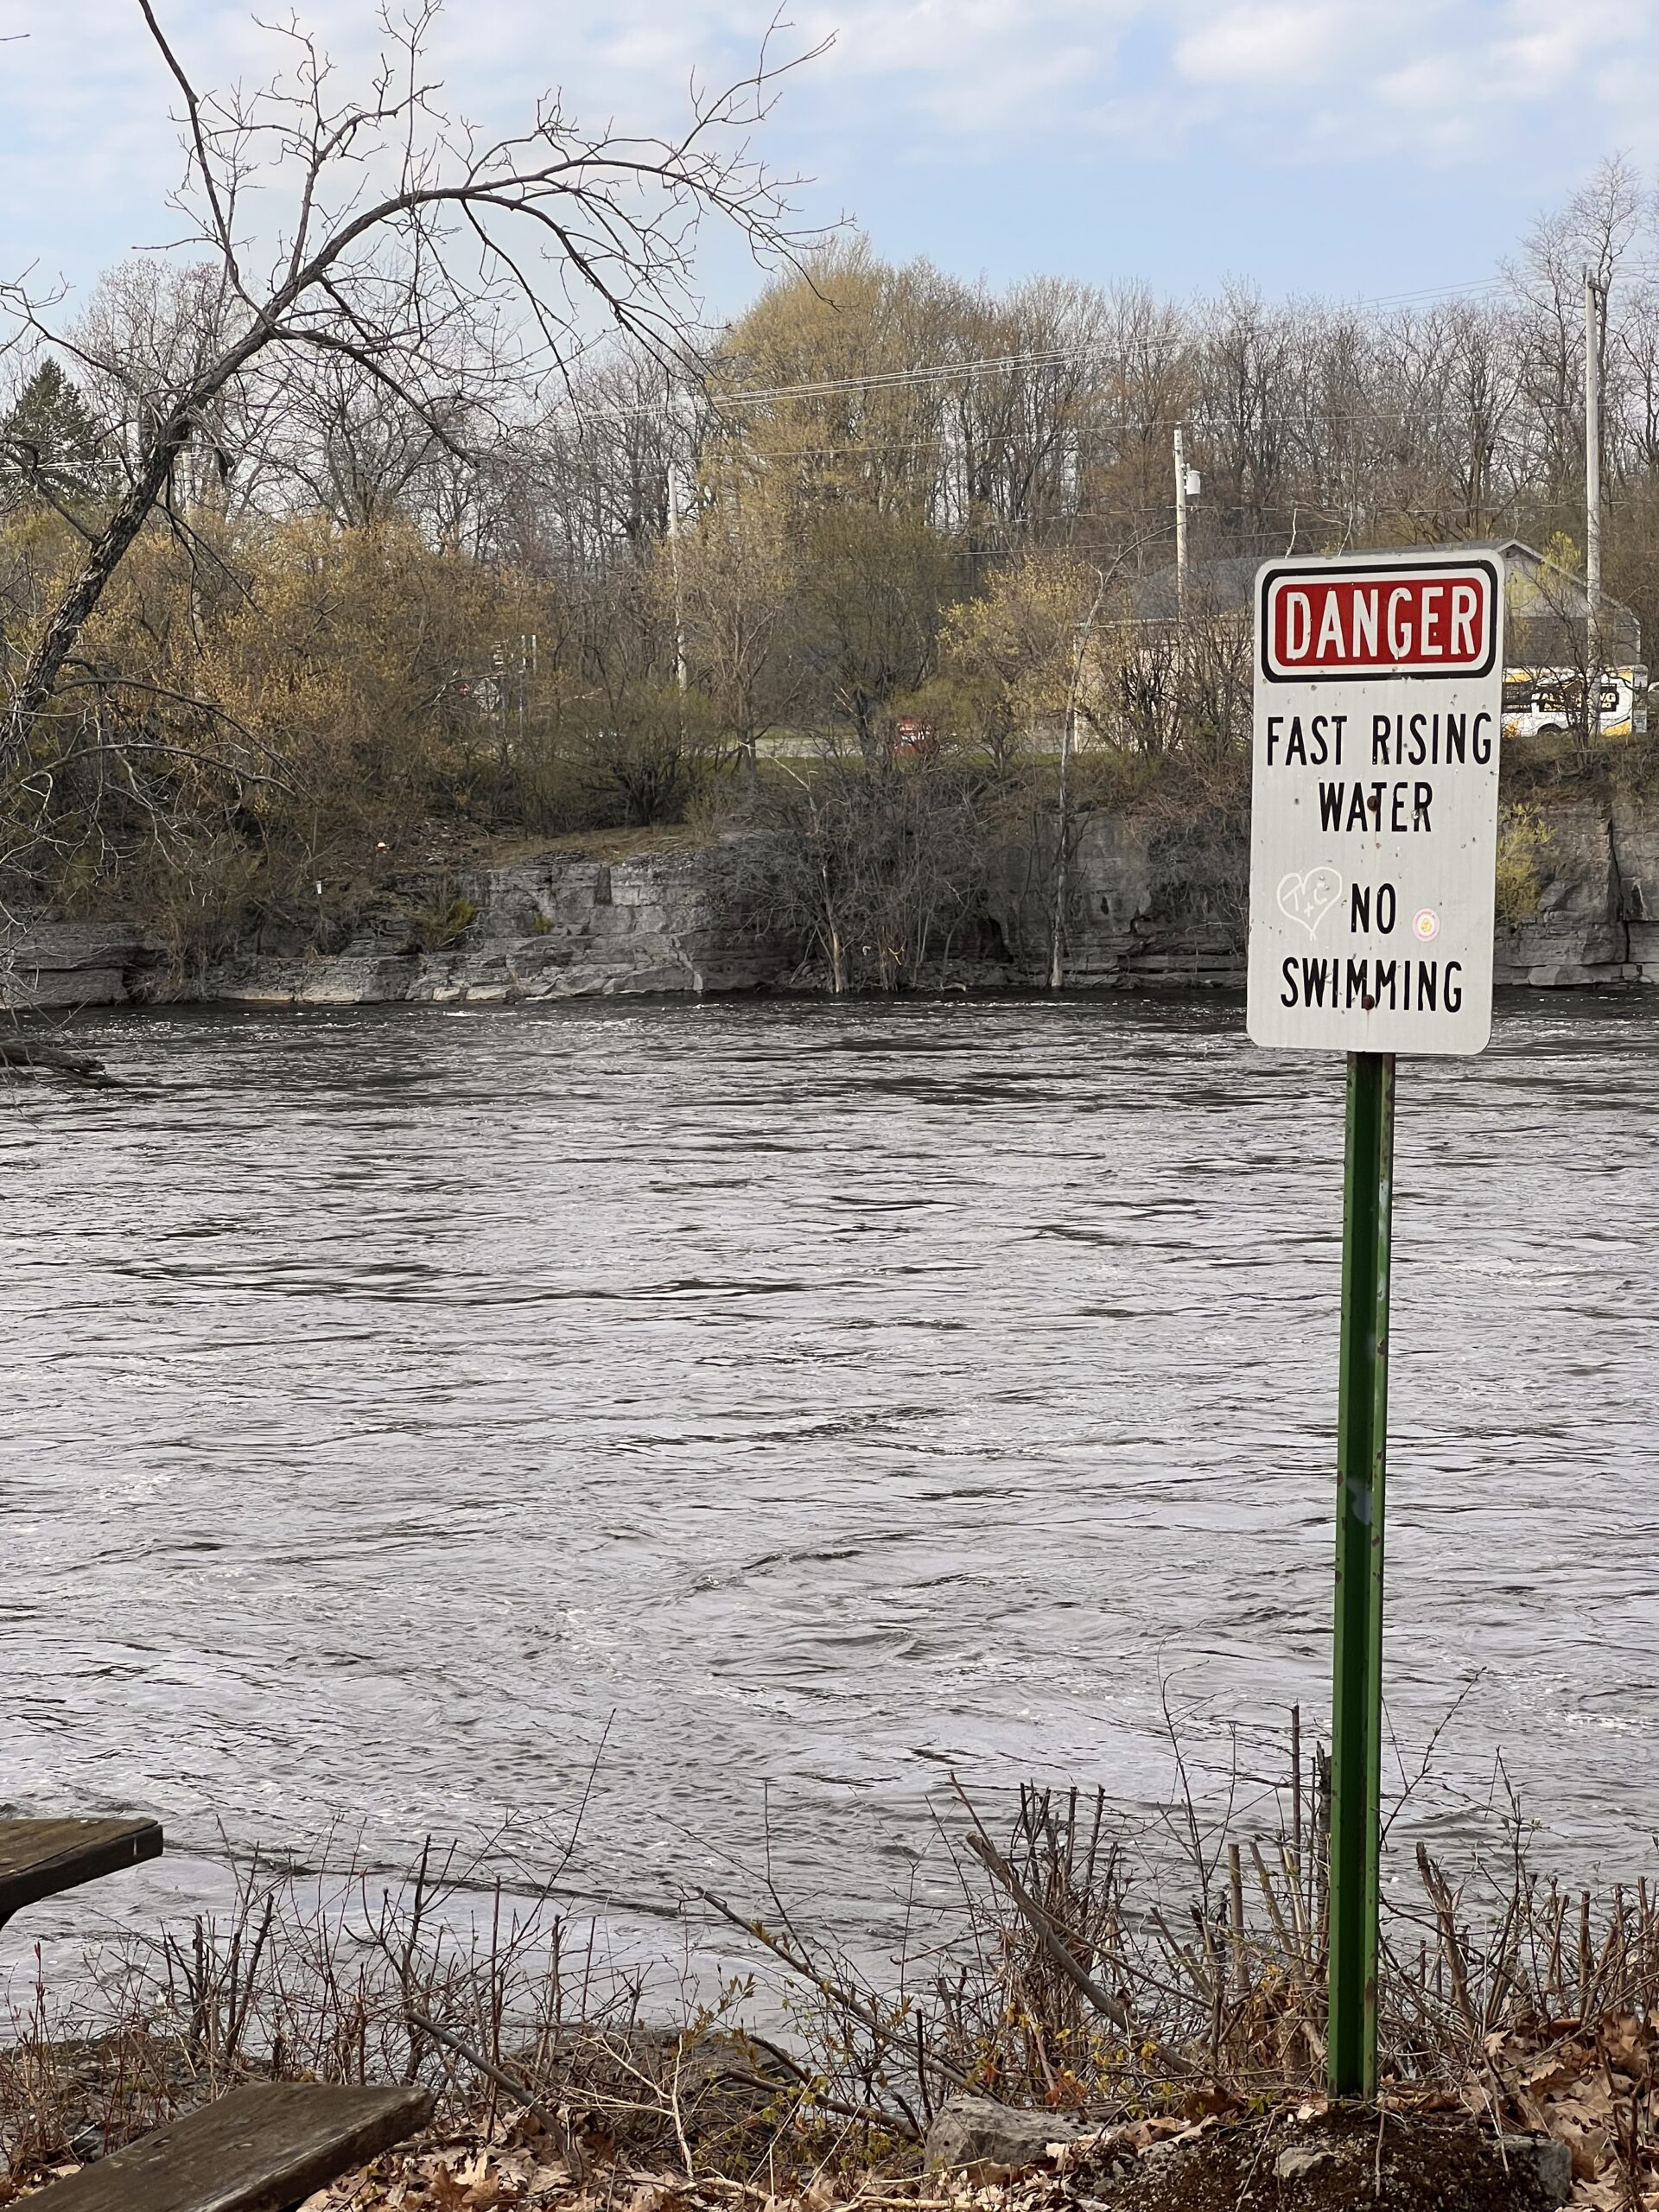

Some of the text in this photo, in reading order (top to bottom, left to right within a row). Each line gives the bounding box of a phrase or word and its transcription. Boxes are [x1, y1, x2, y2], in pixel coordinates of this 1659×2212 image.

[1286, 585, 1478, 660] DANGER
[1267, 712, 1492, 766] FAST RISING
[1319, 781, 1433, 832] WATER
[1351, 882, 1396, 934] NO
[1280, 957, 1463, 1014] SWIMMING
